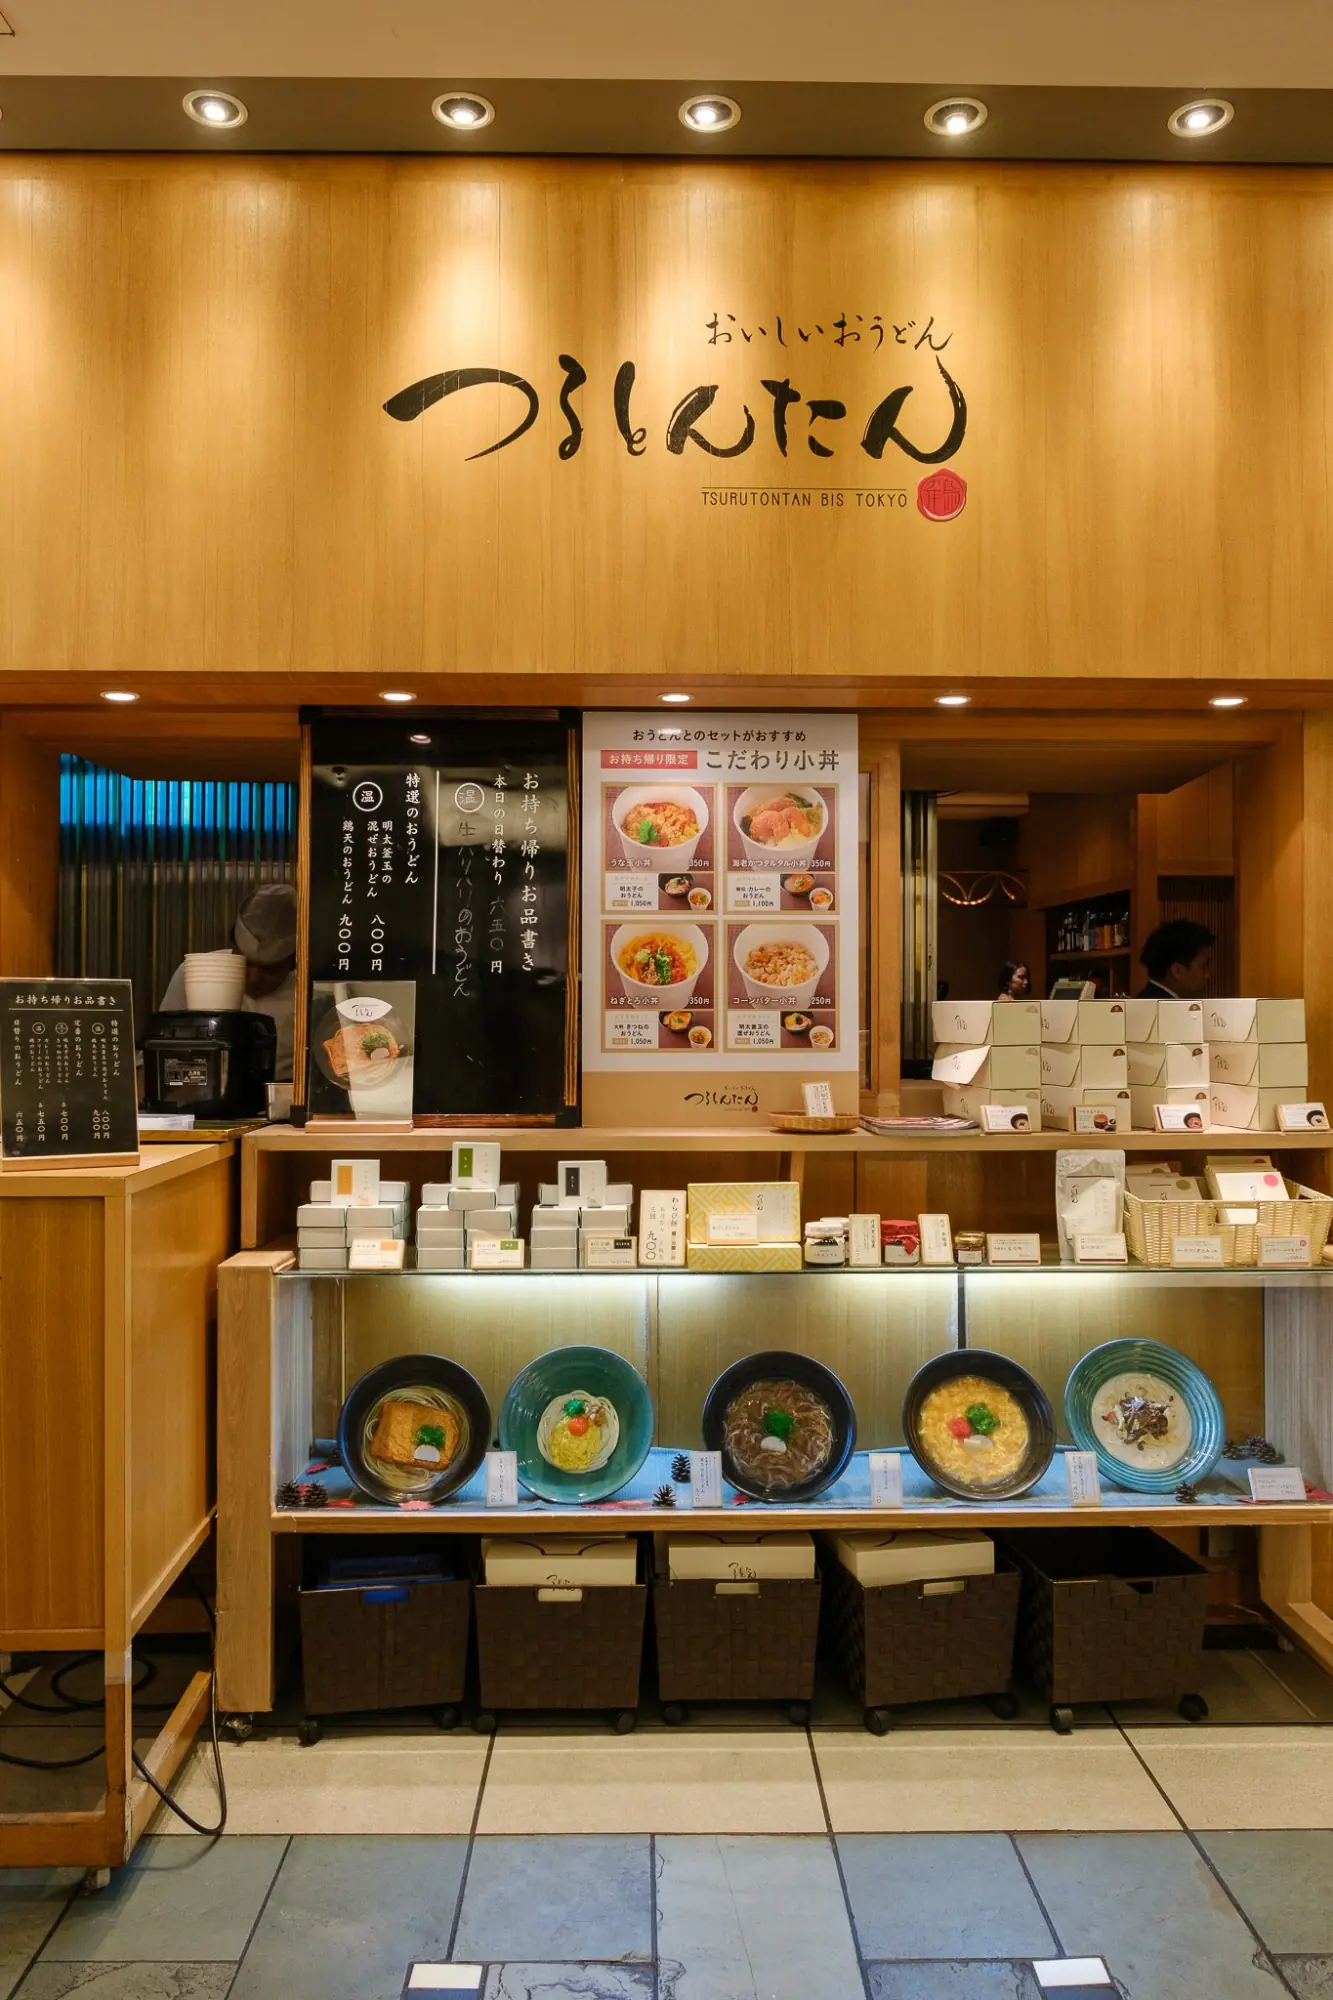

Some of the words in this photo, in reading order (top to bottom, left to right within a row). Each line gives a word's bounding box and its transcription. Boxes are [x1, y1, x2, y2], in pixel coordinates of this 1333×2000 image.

[706, 312, 954, 353] おいしいおうどん
[382, 354, 968, 464] つるとんたん
[702, 491, 812, 507] TSURUTONTAN
[820, 492, 845, 507] BIS
[855, 492, 908, 508] TOKYO
[608, 753, 689, 766] お持ち帰り限定
[705, 749, 839, 771] こだわり小丼
[404, 772, 421, 884] 特選のおうどん
[491, 774, 508, 886] 本日の日替わり
[341, 819, 355, 905] 鶏天のおうどん
[366, 820, 379, 898] 混ぜおうどん
[381, 819, 394, 884] 明太釜玉の
[610, 858, 652, 868] うな玉小丼
[689, 858, 710, 868] 350円
[811, 859, 831, 868] 350円
[519, 772, 541, 972] お持ち帰りお品書き
[15, 994, 117, 1006] お持ち帰りお品書き
[609, 996, 660, 1005] ねぎとろ小丼
[689, 996, 710, 1005] 350円
[732, 996, 797, 1005] コーンバター小丼
[810, 996, 831, 1005] 250円
